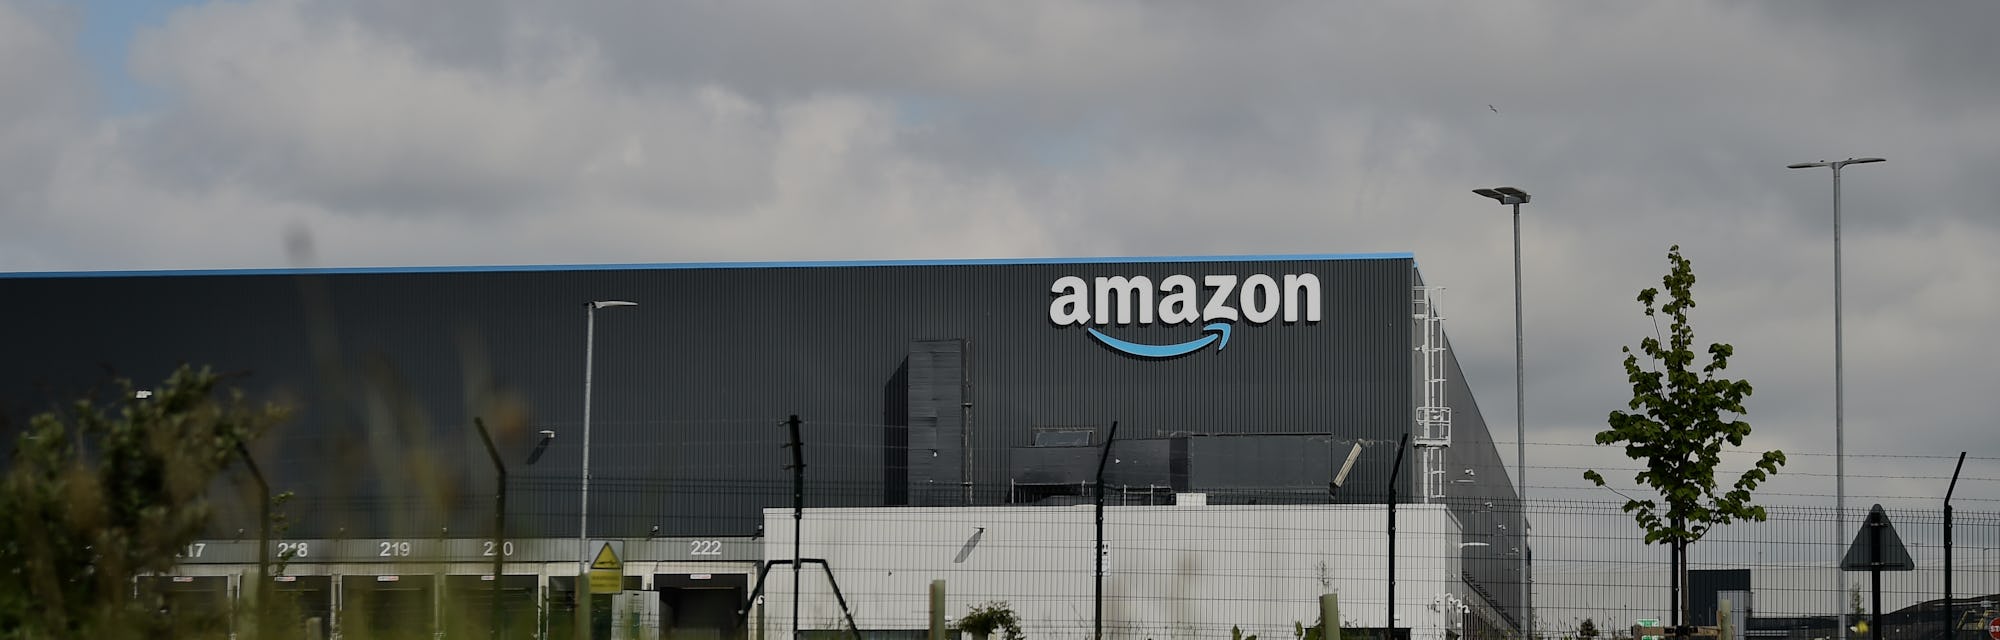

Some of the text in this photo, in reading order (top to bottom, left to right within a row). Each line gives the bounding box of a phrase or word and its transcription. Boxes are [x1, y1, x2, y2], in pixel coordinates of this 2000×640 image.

[1050, 273, 1321, 326] amazon
[176, 543, 206, 558] 17
[379, 541, 410, 557] 219
[483, 541, 514, 556] 20
[690, 540, 721, 555] 222
